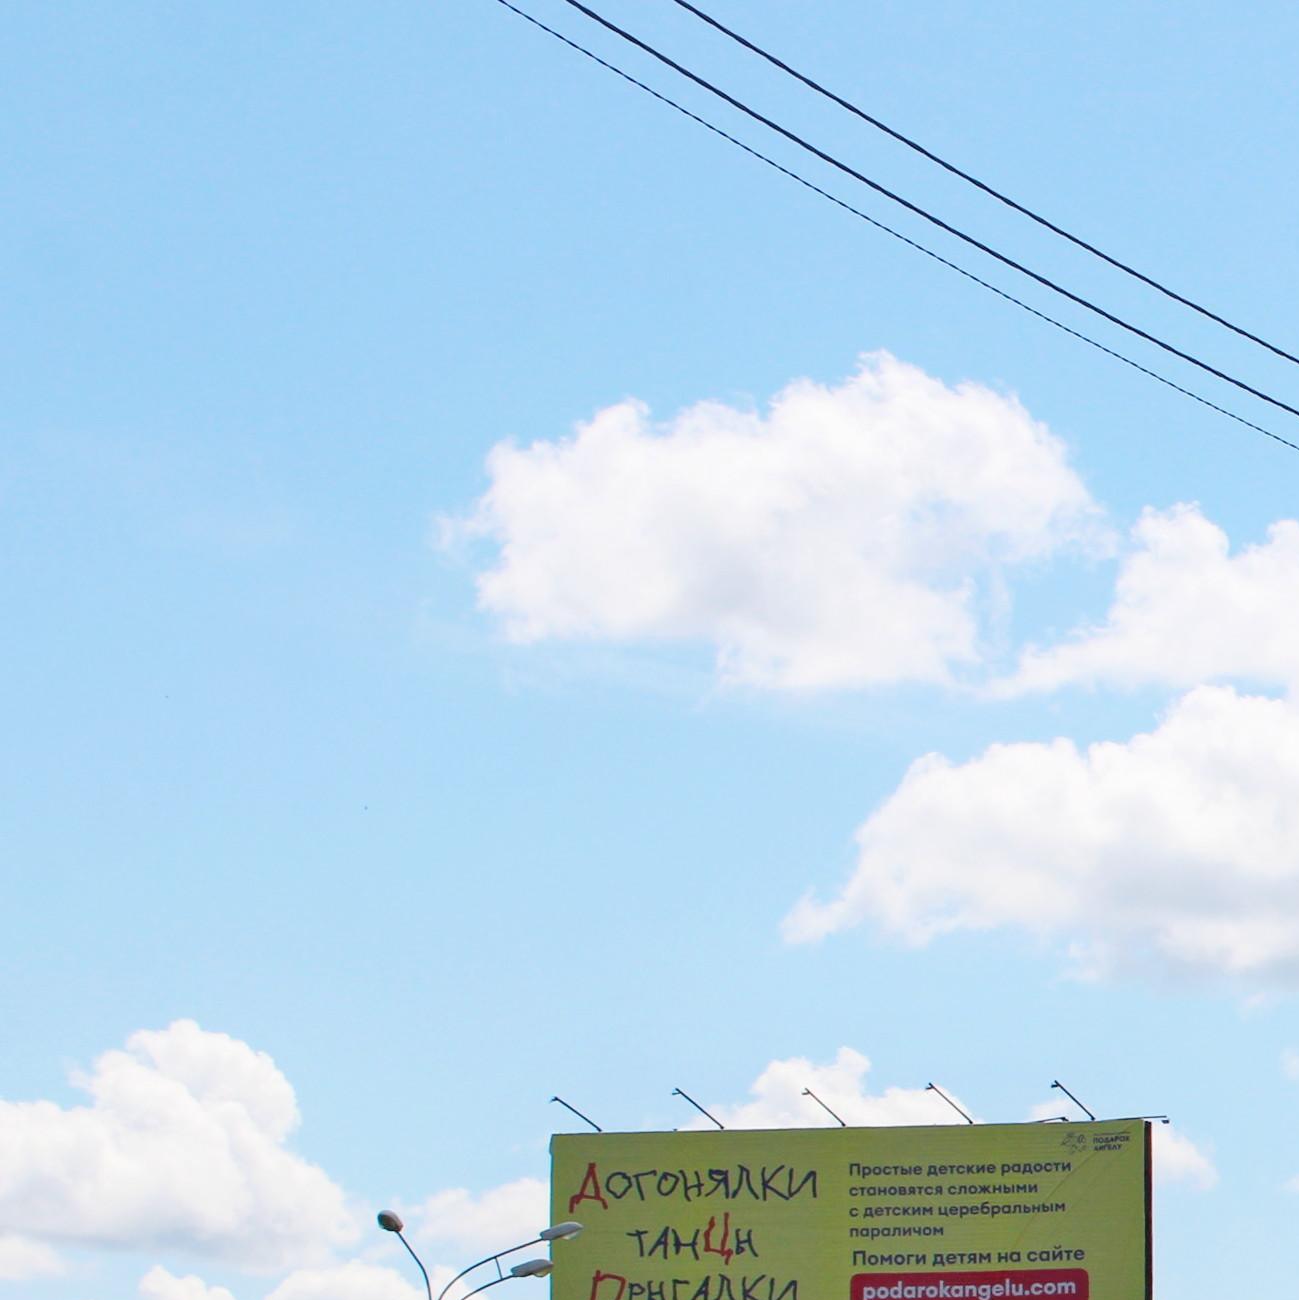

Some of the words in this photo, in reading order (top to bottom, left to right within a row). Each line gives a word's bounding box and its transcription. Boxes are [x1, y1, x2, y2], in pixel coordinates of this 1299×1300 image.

[849, 1163, 922, 1178] Простые
[927, 1162, 996, 1177] детские
[1001, 1160, 1072, 1176] радости
[569, 1162, 817, 1214] ДОГОНЯЛКИ
[849, 1184, 943, 1197] становятся
[947, 1181, 1038, 1196] сложными
[849, 1206, 859, 1217] с
[863, 1204, 933, 1219] детским
[938, 1200, 1066, 1218] церебральным
[849, 1224, 944, 1240] параличом
[852, 1250, 926, 1267] Помоги
[932, 1250, 992, 1267] детям
[998, 1249, 1021, 1263] на
[1027, 1245, 1085, 1262] сайте
